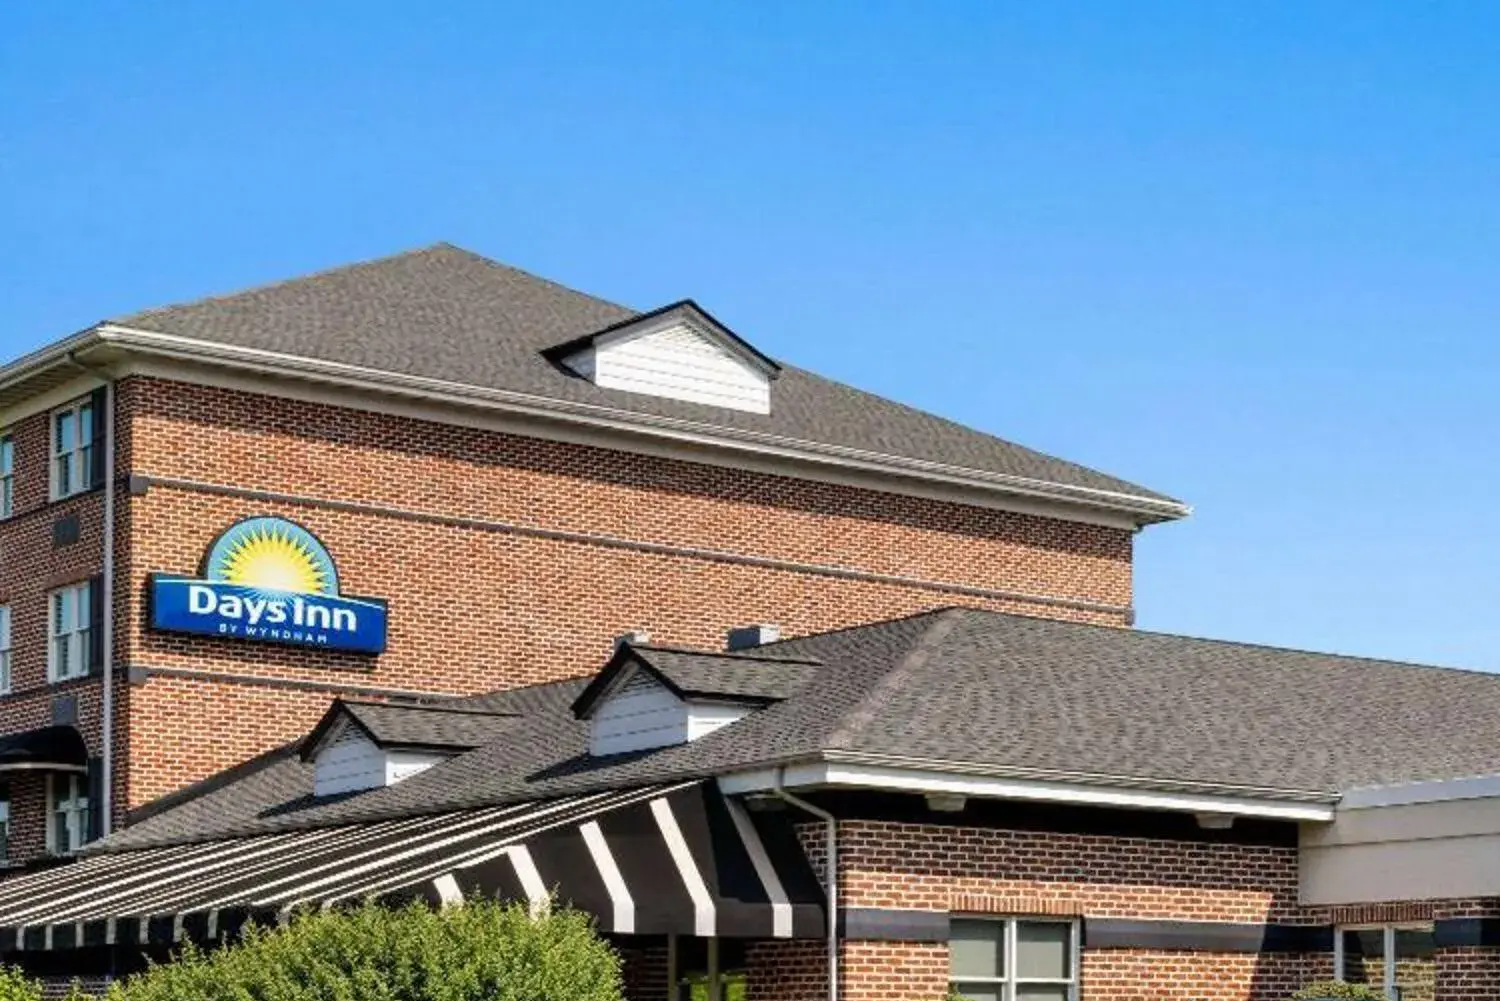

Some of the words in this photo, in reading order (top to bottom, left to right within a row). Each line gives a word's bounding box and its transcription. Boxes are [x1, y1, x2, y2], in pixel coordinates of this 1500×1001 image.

[189, 585, 288, 625] Days
[293, 598, 357, 632] Inn
[219, 623, 238, 634] BY
[246, 626, 328, 644] WYNDHAM
